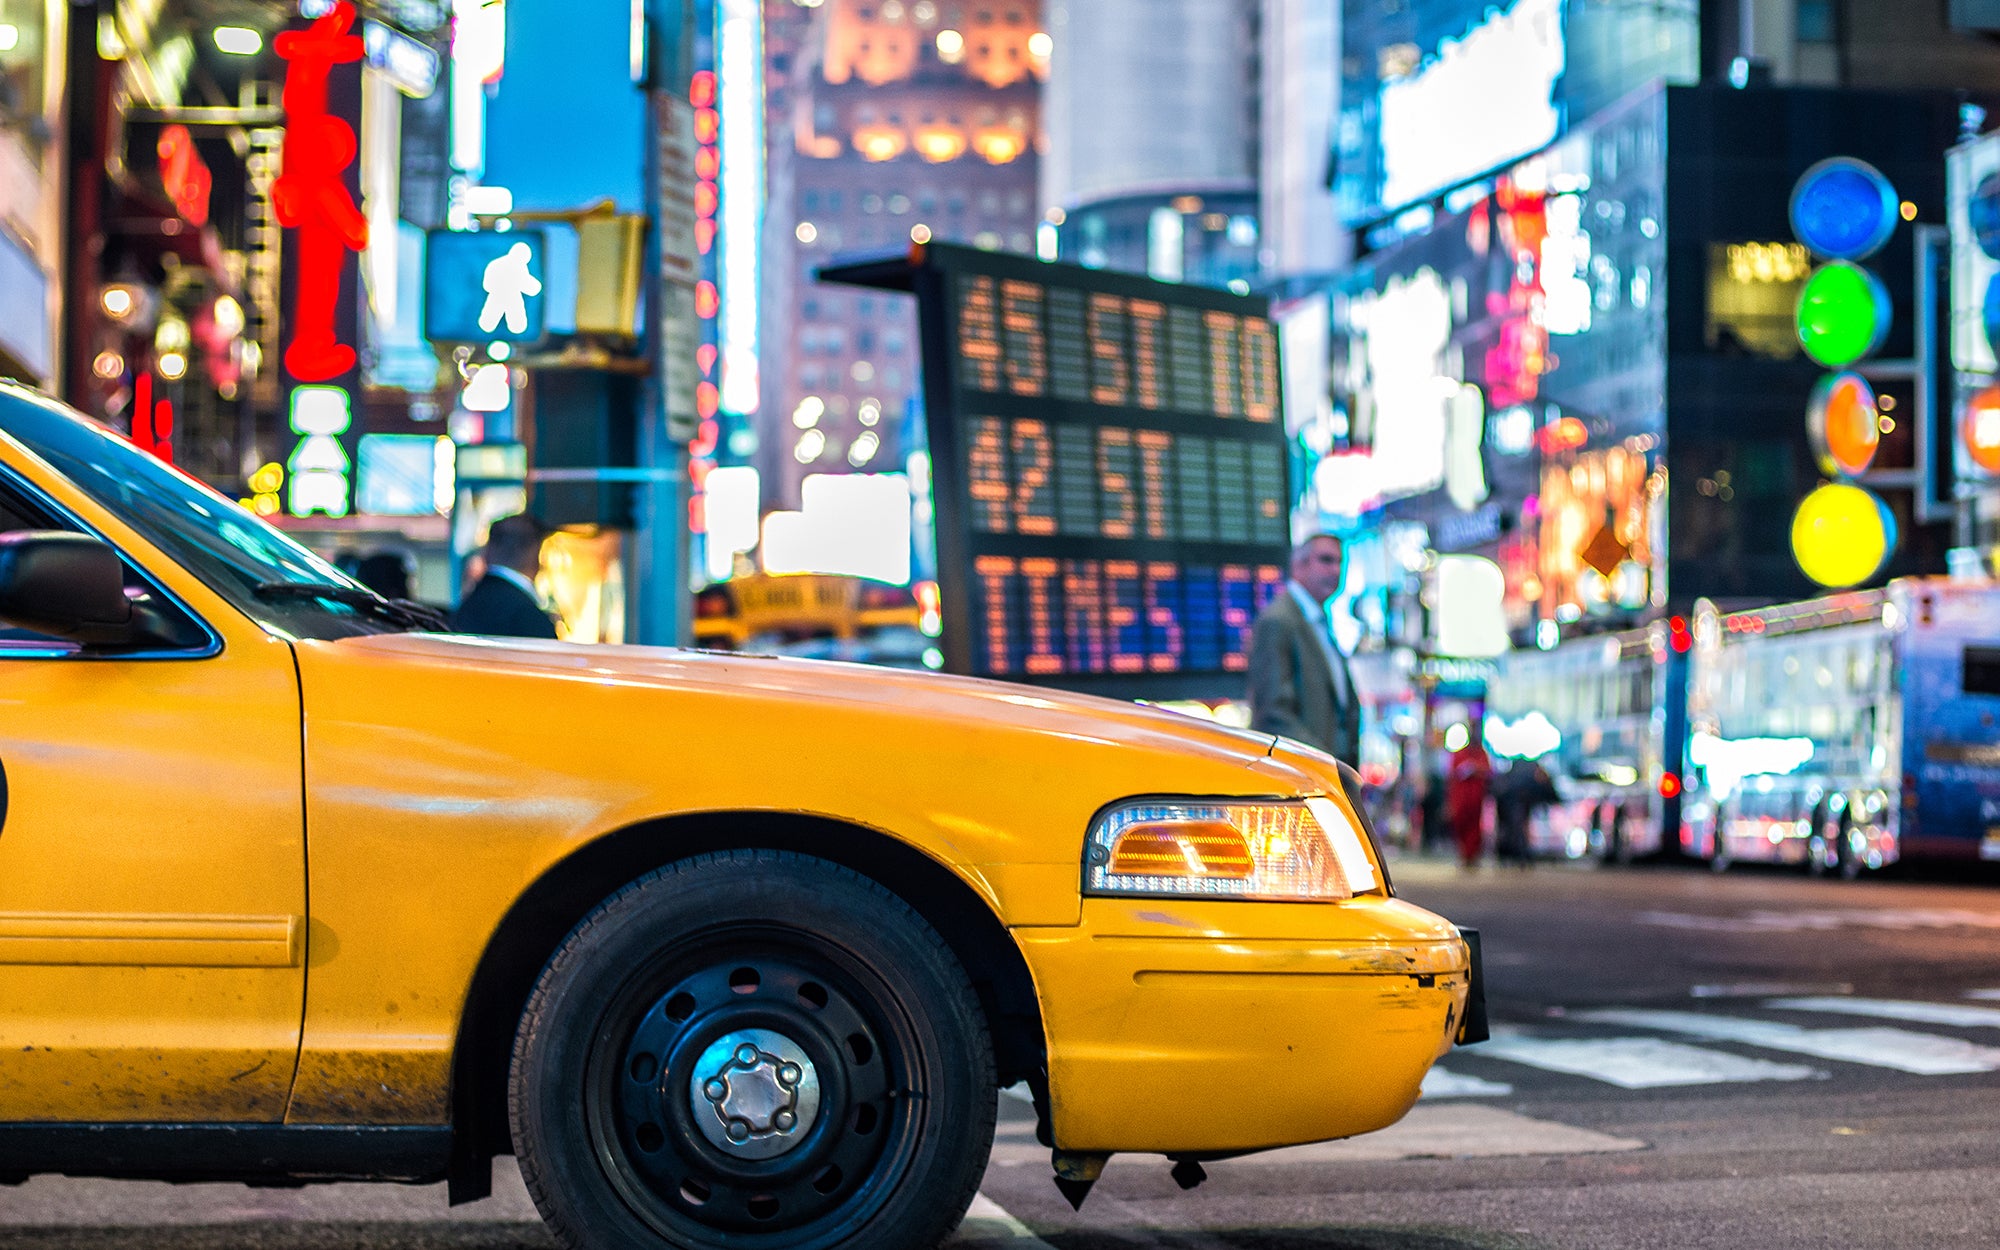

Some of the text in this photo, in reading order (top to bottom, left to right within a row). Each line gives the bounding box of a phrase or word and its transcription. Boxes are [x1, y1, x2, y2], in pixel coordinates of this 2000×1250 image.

[959, 275, 1277, 423] 45 ST TO
[969, 416, 1173, 540] 42 ST
[974, 556, 1183, 676] TIMES
